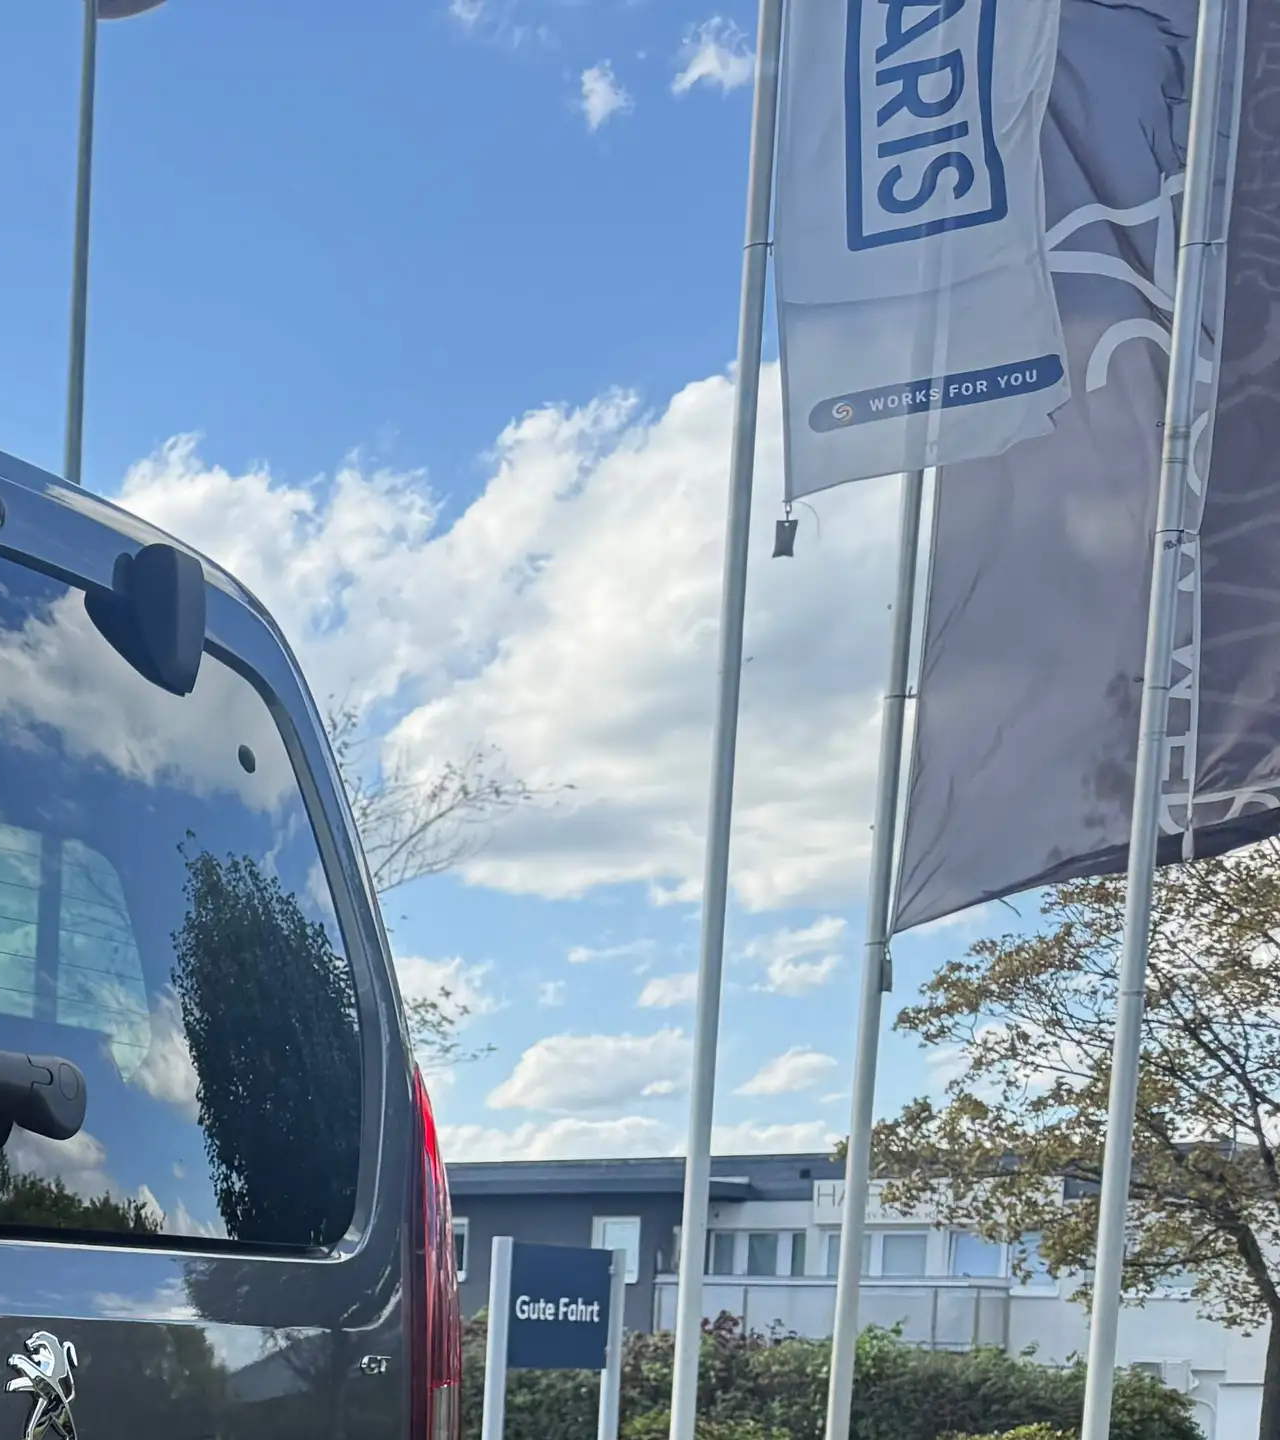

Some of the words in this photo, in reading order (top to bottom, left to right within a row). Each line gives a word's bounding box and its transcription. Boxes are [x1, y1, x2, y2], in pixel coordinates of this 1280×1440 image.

[869, 388, 940, 413] WORKS
[949, 378, 989, 399] FOR
[996, 368, 1039, 390] YOU
[515, 1295, 555, 1321] Gute
[558, 1297, 600, 1323] Fahrt
